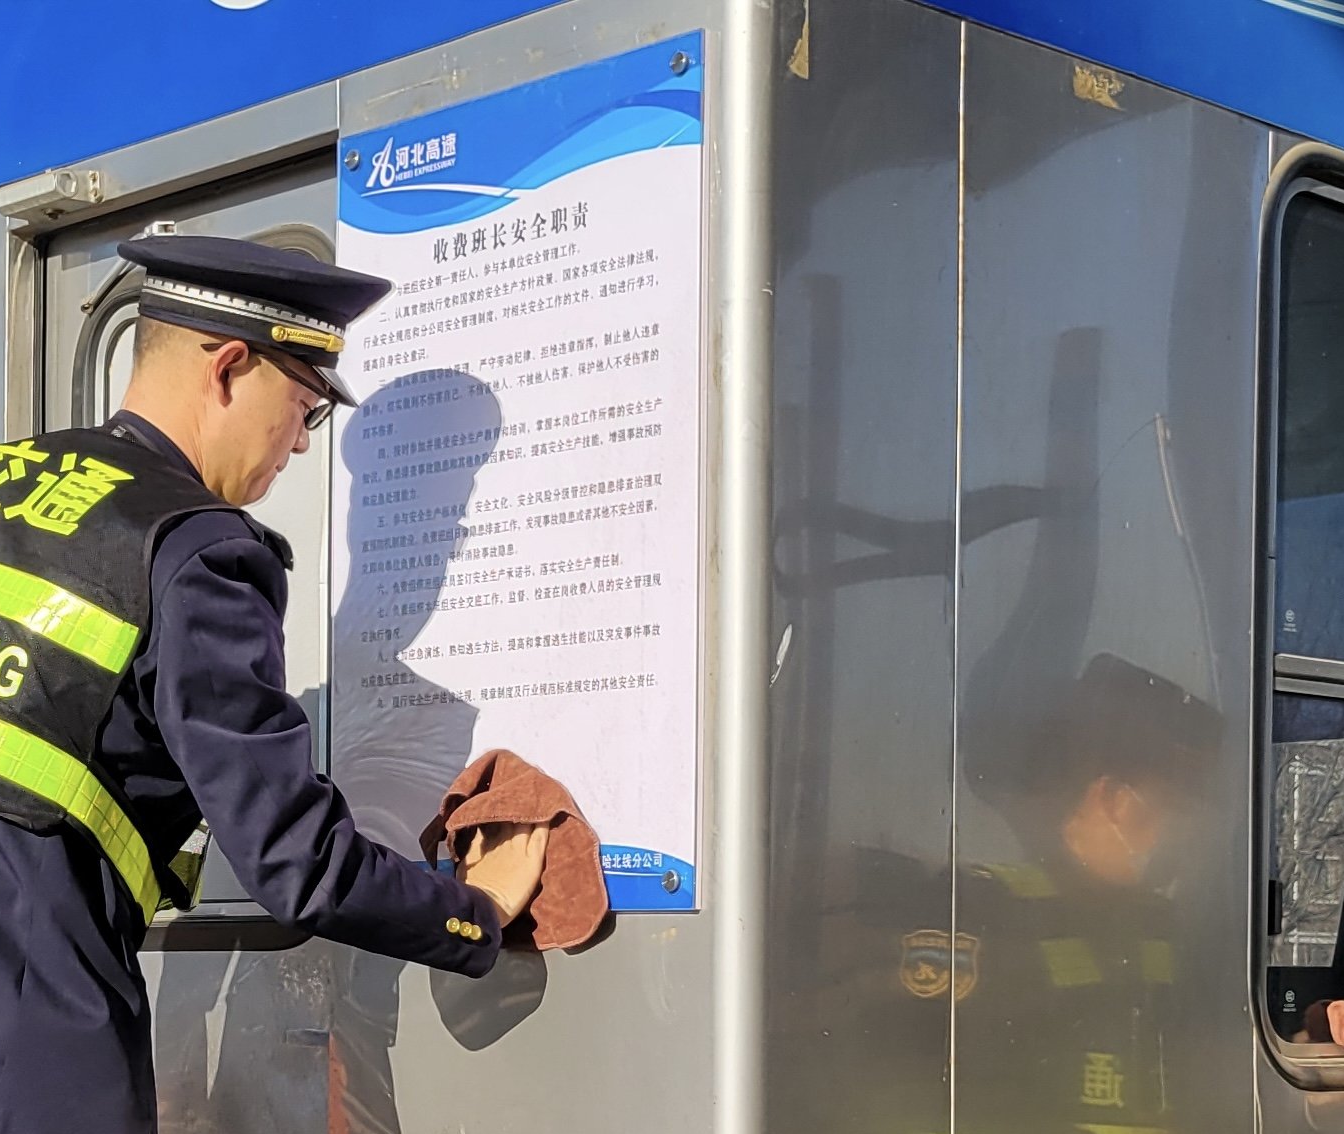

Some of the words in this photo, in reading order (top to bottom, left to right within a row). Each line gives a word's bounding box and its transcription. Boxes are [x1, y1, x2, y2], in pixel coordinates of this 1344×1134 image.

[395, 132, 457, 171] 河北高速
[433, 201, 590, 265] 收费班长安全职责
